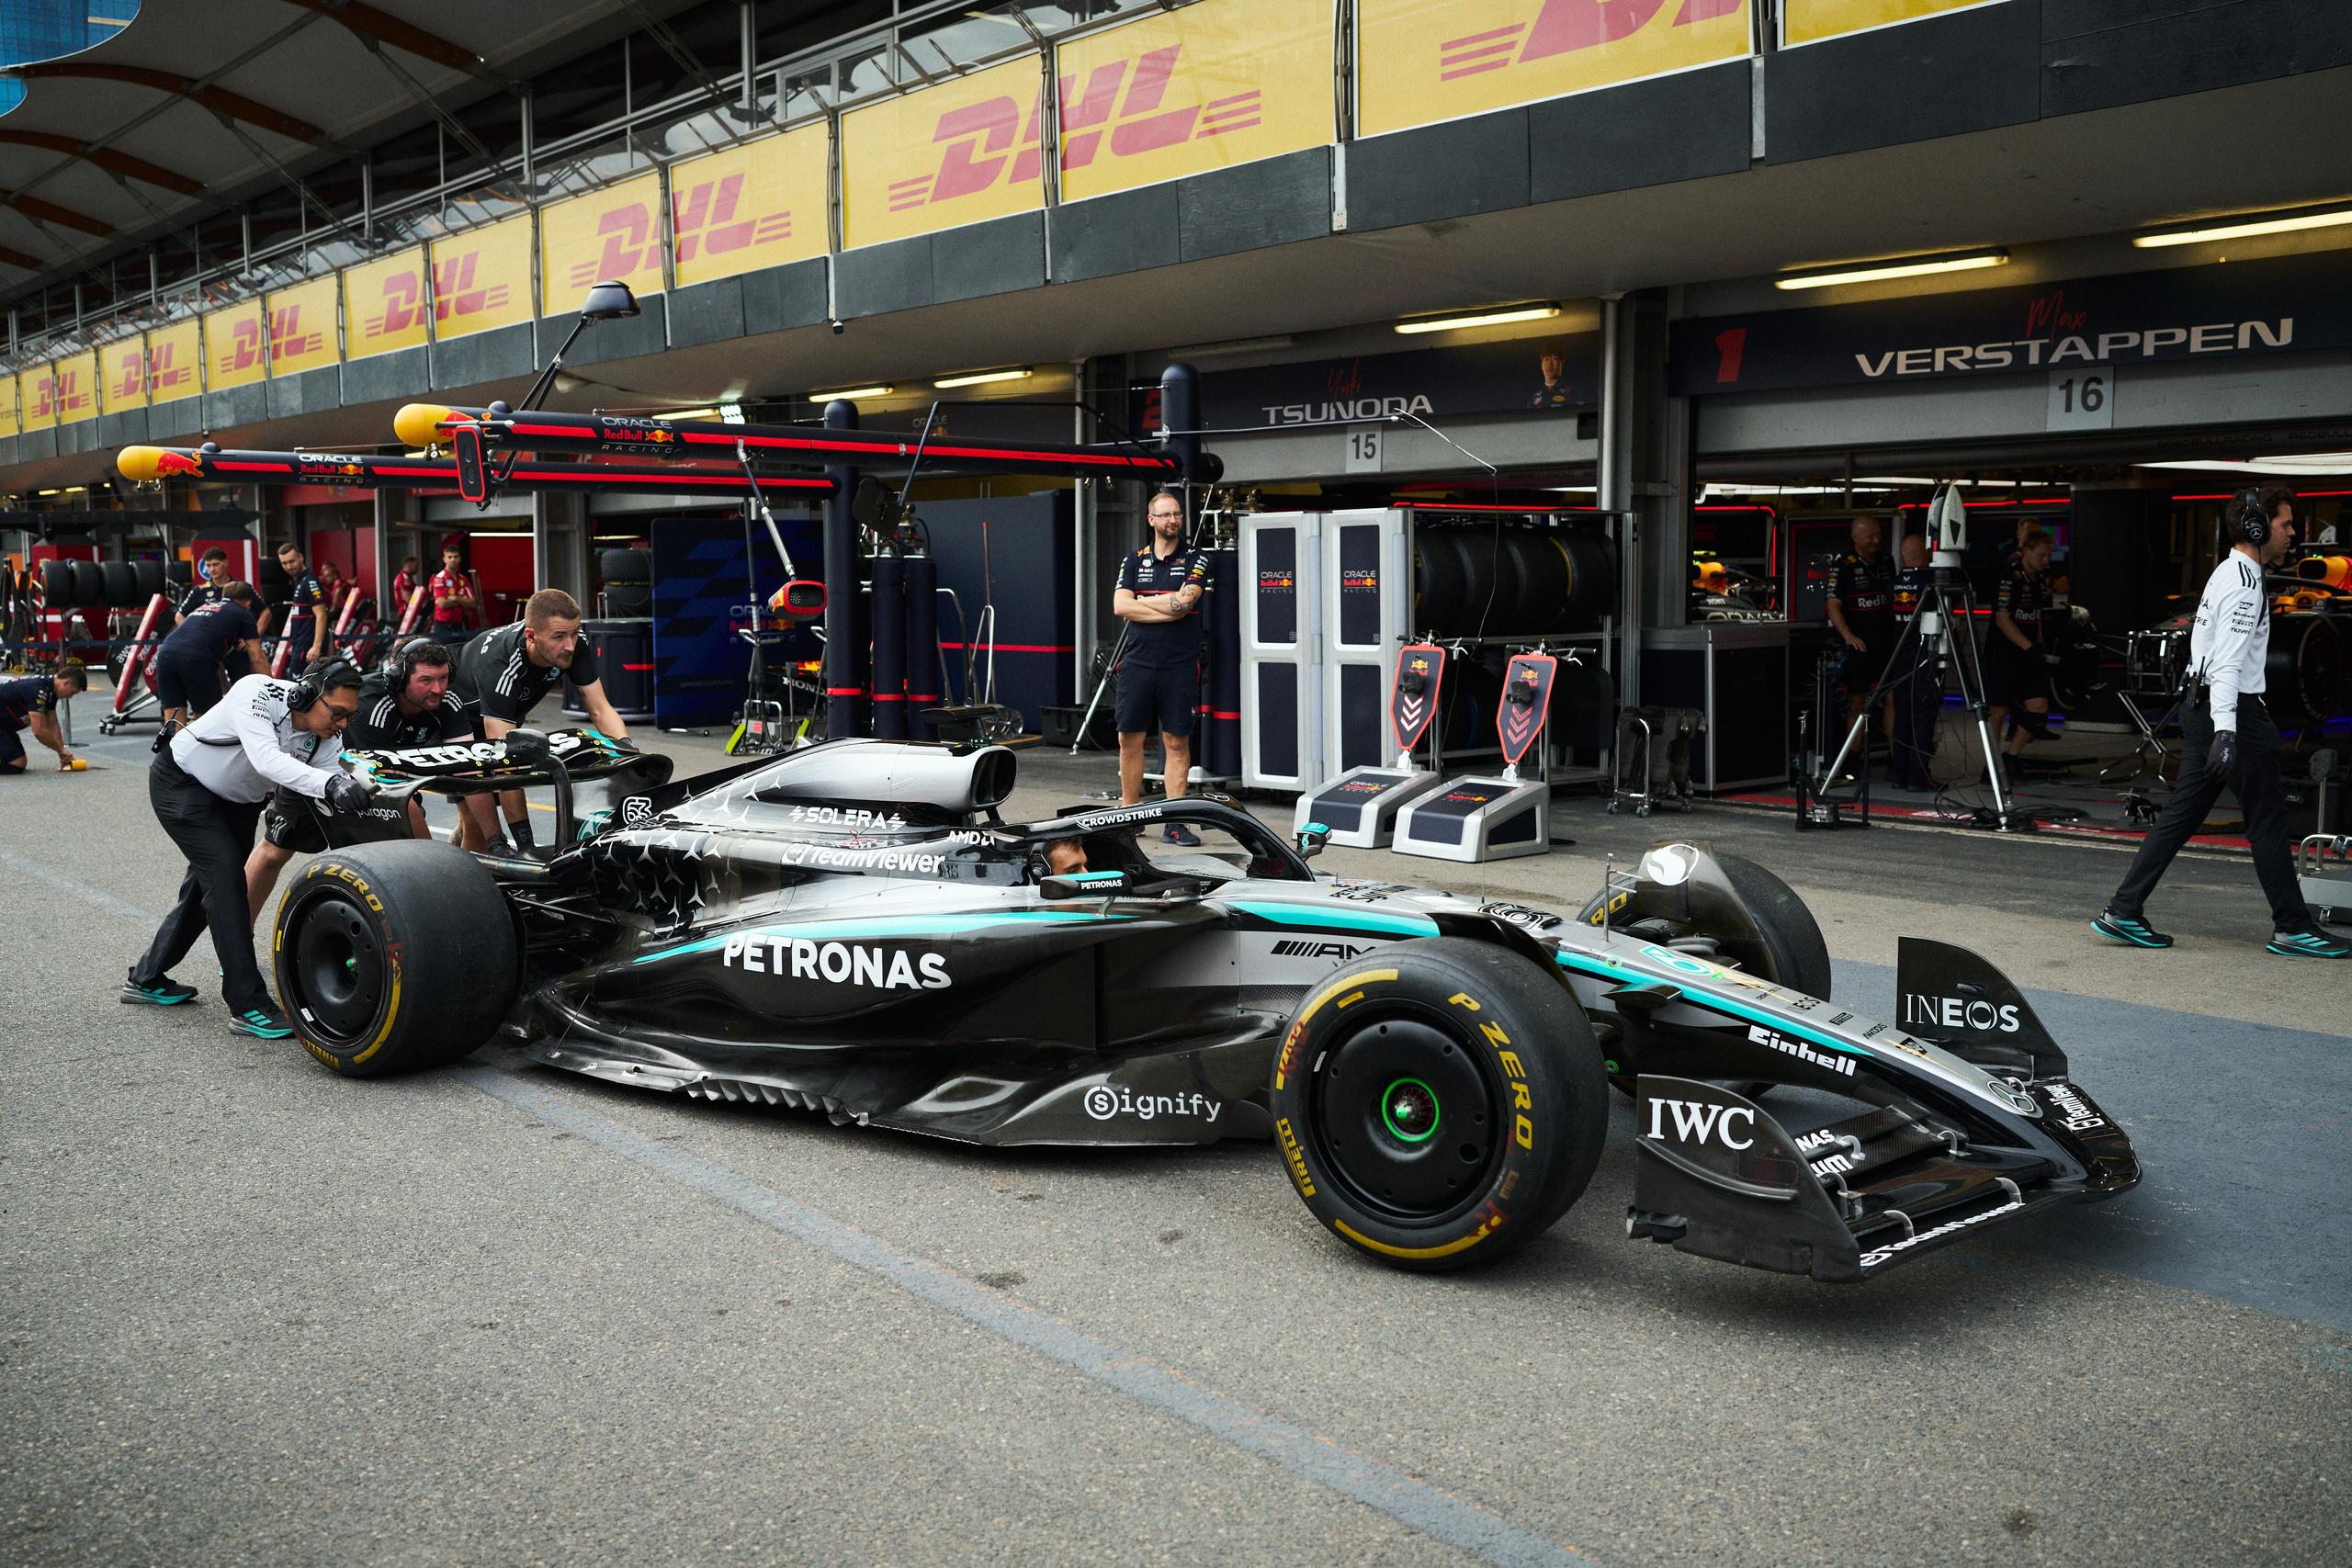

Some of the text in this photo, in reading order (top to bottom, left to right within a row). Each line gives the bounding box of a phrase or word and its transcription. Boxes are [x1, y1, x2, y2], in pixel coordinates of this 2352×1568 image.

[929, 43, 1201, 204] DHL
[594, 174, 757, 283] DHL
[382, 251, 488, 334] DHL
[2026, 290, 2087, 345] Max
[232, 304, 307, 370] DHL
[1714, 327, 1747, 383] 1
[1855, 317, 2294, 378] VERSTAPPEN
[122, 343, 179, 397] DHL
[1328, 356, 1363, 408] Yuki
[39, 370, 81, 416] DHL
[1262, 394, 1434, 425] TSUNODA
[2057, 377, 2104, 413] 16
[601, 417, 673, 429] ORACLE
[912, 415, 947, 428] ORLE
[299, 454, 363, 464] ORACLE
[602, 445, 673, 454] RACING
[1351, 433, 1377, 460] 15
[1260, 570, 1293, 579] ORACLE
[1343, 570, 1376, 579] ORACLE
[1808, 553, 1842, 565] ORA
[372, 732, 582, 767] PETROS
[622, 795, 652, 826] 63
[804, 807, 888, 829] SOLERA
[1081, 807, 1163, 828] CROWDSTRIKE
[945, 830, 981, 845] AMD
[809, 846, 946, 874] TeamViewer
[307, 863, 385, 912] P ZERO
[1080, 879, 1123, 891] PETRONAS
[723, 932, 952, 990] PETRONAS
[1829, 1012, 1854, 1026] PIRELLI
[1905, 993, 2019, 1032] INEOS
[303, 1038, 342, 1071] PIRELLI
[1747, 1024, 1857, 1077] Einhell
[1448, 992, 1482, 1012] P
[1478, 1021, 1533, 1151] ZERO
[2042, 1084, 2095, 1123] TeamViewer
[1647, 1097, 1755, 1151] IWC
[1794, 1128, 1837, 1152] NAS
[1276, 1118, 1317, 1198] PIRELLI
[1871, 1201, 2027, 1254] TeamViewer
